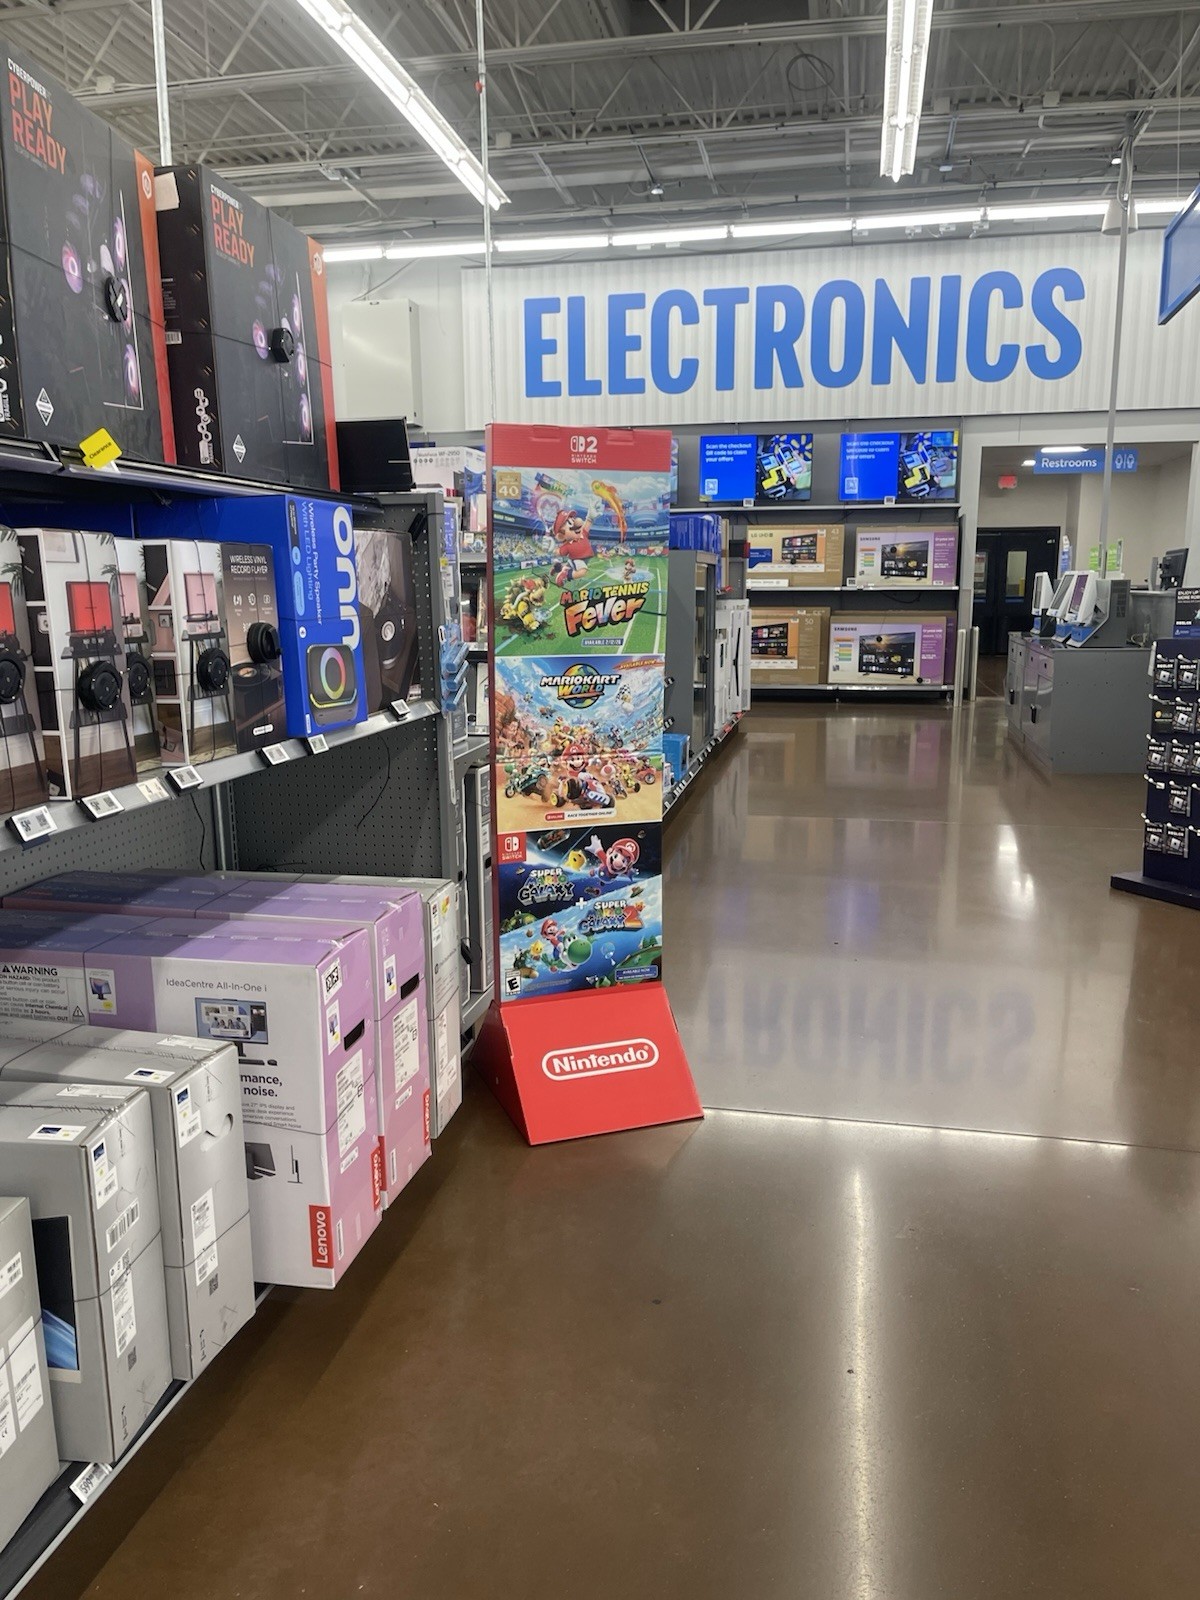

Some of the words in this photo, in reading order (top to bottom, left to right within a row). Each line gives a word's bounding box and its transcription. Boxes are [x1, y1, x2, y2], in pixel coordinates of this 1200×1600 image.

[8, 71, 53, 134] PLAY
[12, 108, 67, 175] READY
[211, 194, 244, 237] PLAY
[213, 223, 255, 268] READY
[524, 267, 1086, 397] ELECTRONICS
[586, 436, 598, 453] 2
[1041, 458, 1097, 468] Restrooms
[499, 485, 519, 496] 40
[301, 501, 310, 529] With
[308, 501, 319, 549] Wireless
[304, 530, 312, 554] LED
[229, 554, 253, 565] WIRELESS
[253, 555, 268, 565] VINYL
[230, 565, 251, 574] RECORD
[312, 551, 321, 591] Party
[561, 585, 603, 604] MARIO
[602, 582, 650, 598] TENNIS
[314, 591, 324, 627] Speaker
[540, 675, 582, 686] MARIO
[582, 674, 621, 685] KART
[560, 684, 604, 697] WORLD
[530, 868, 563, 877] SUPER
[518, 882, 575, 905] GALAXY
[594, 900, 627, 909] SUPER
[578, 915, 626, 934] GALAXY
[11, 965, 58, 976] WARNING
[166, 979, 214, 989] IdeaCentre
[216, 981, 262, 992] All-In-One
[552, 1043, 652, 1074] Nintendo
[240, 1074, 283, 1087] mance,
[243, 1086, 278, 1097] noise.
[316, 1211, 328, 1264] Lenovo
